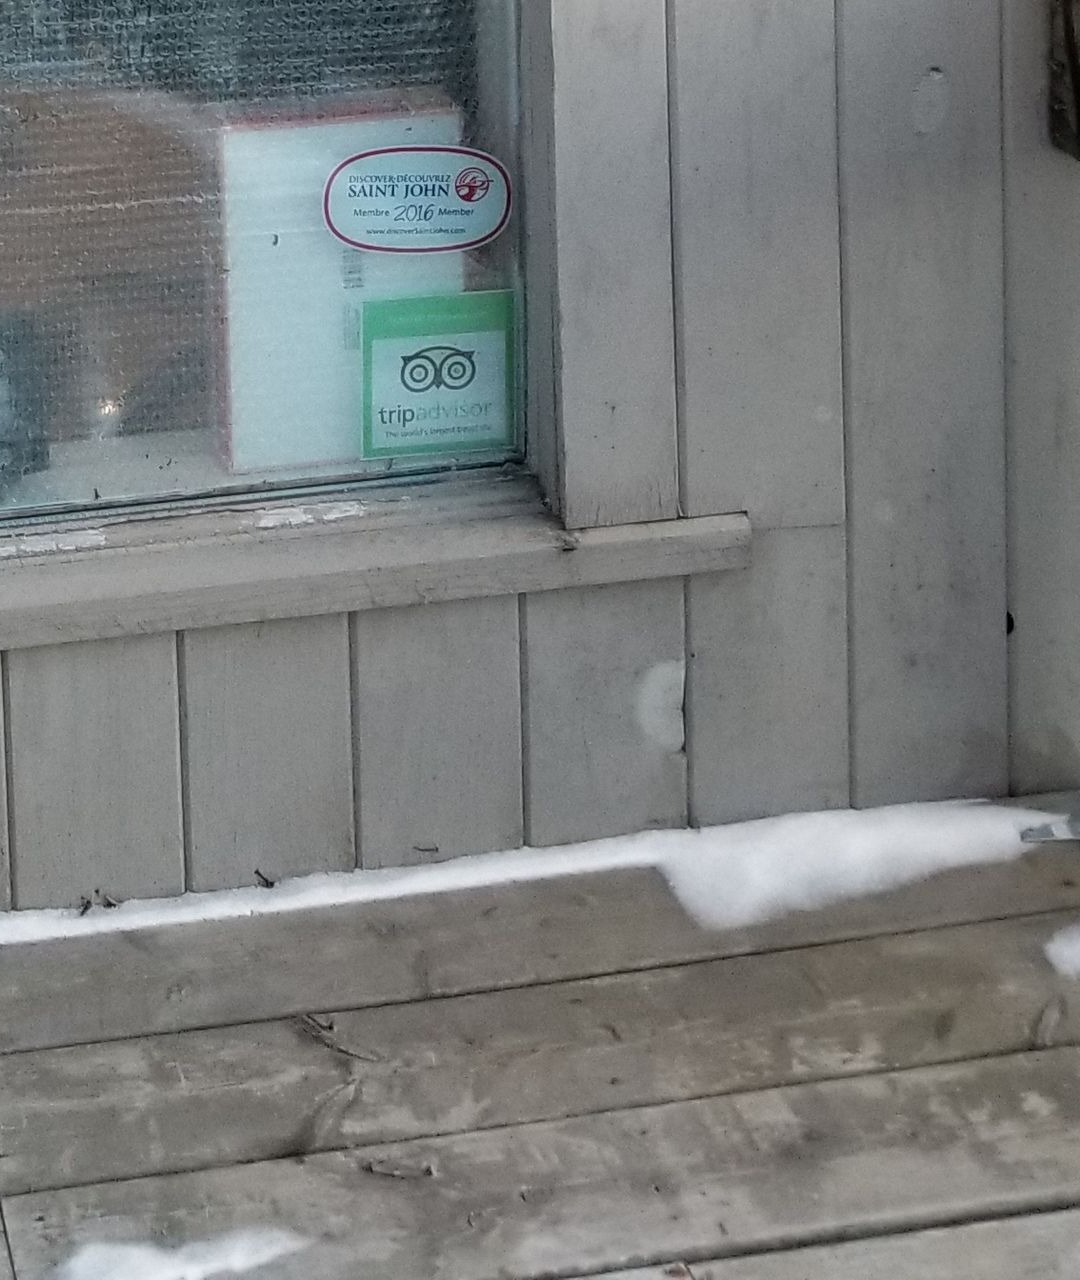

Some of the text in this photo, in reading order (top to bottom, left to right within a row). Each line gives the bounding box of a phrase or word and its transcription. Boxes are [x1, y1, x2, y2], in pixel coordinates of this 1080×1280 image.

[348, 183, 451, 200] SAINT JOHN
[353, 203, 475, 222] Membre 2016 Member
[378, 402, 493, 428] tripadvisor
